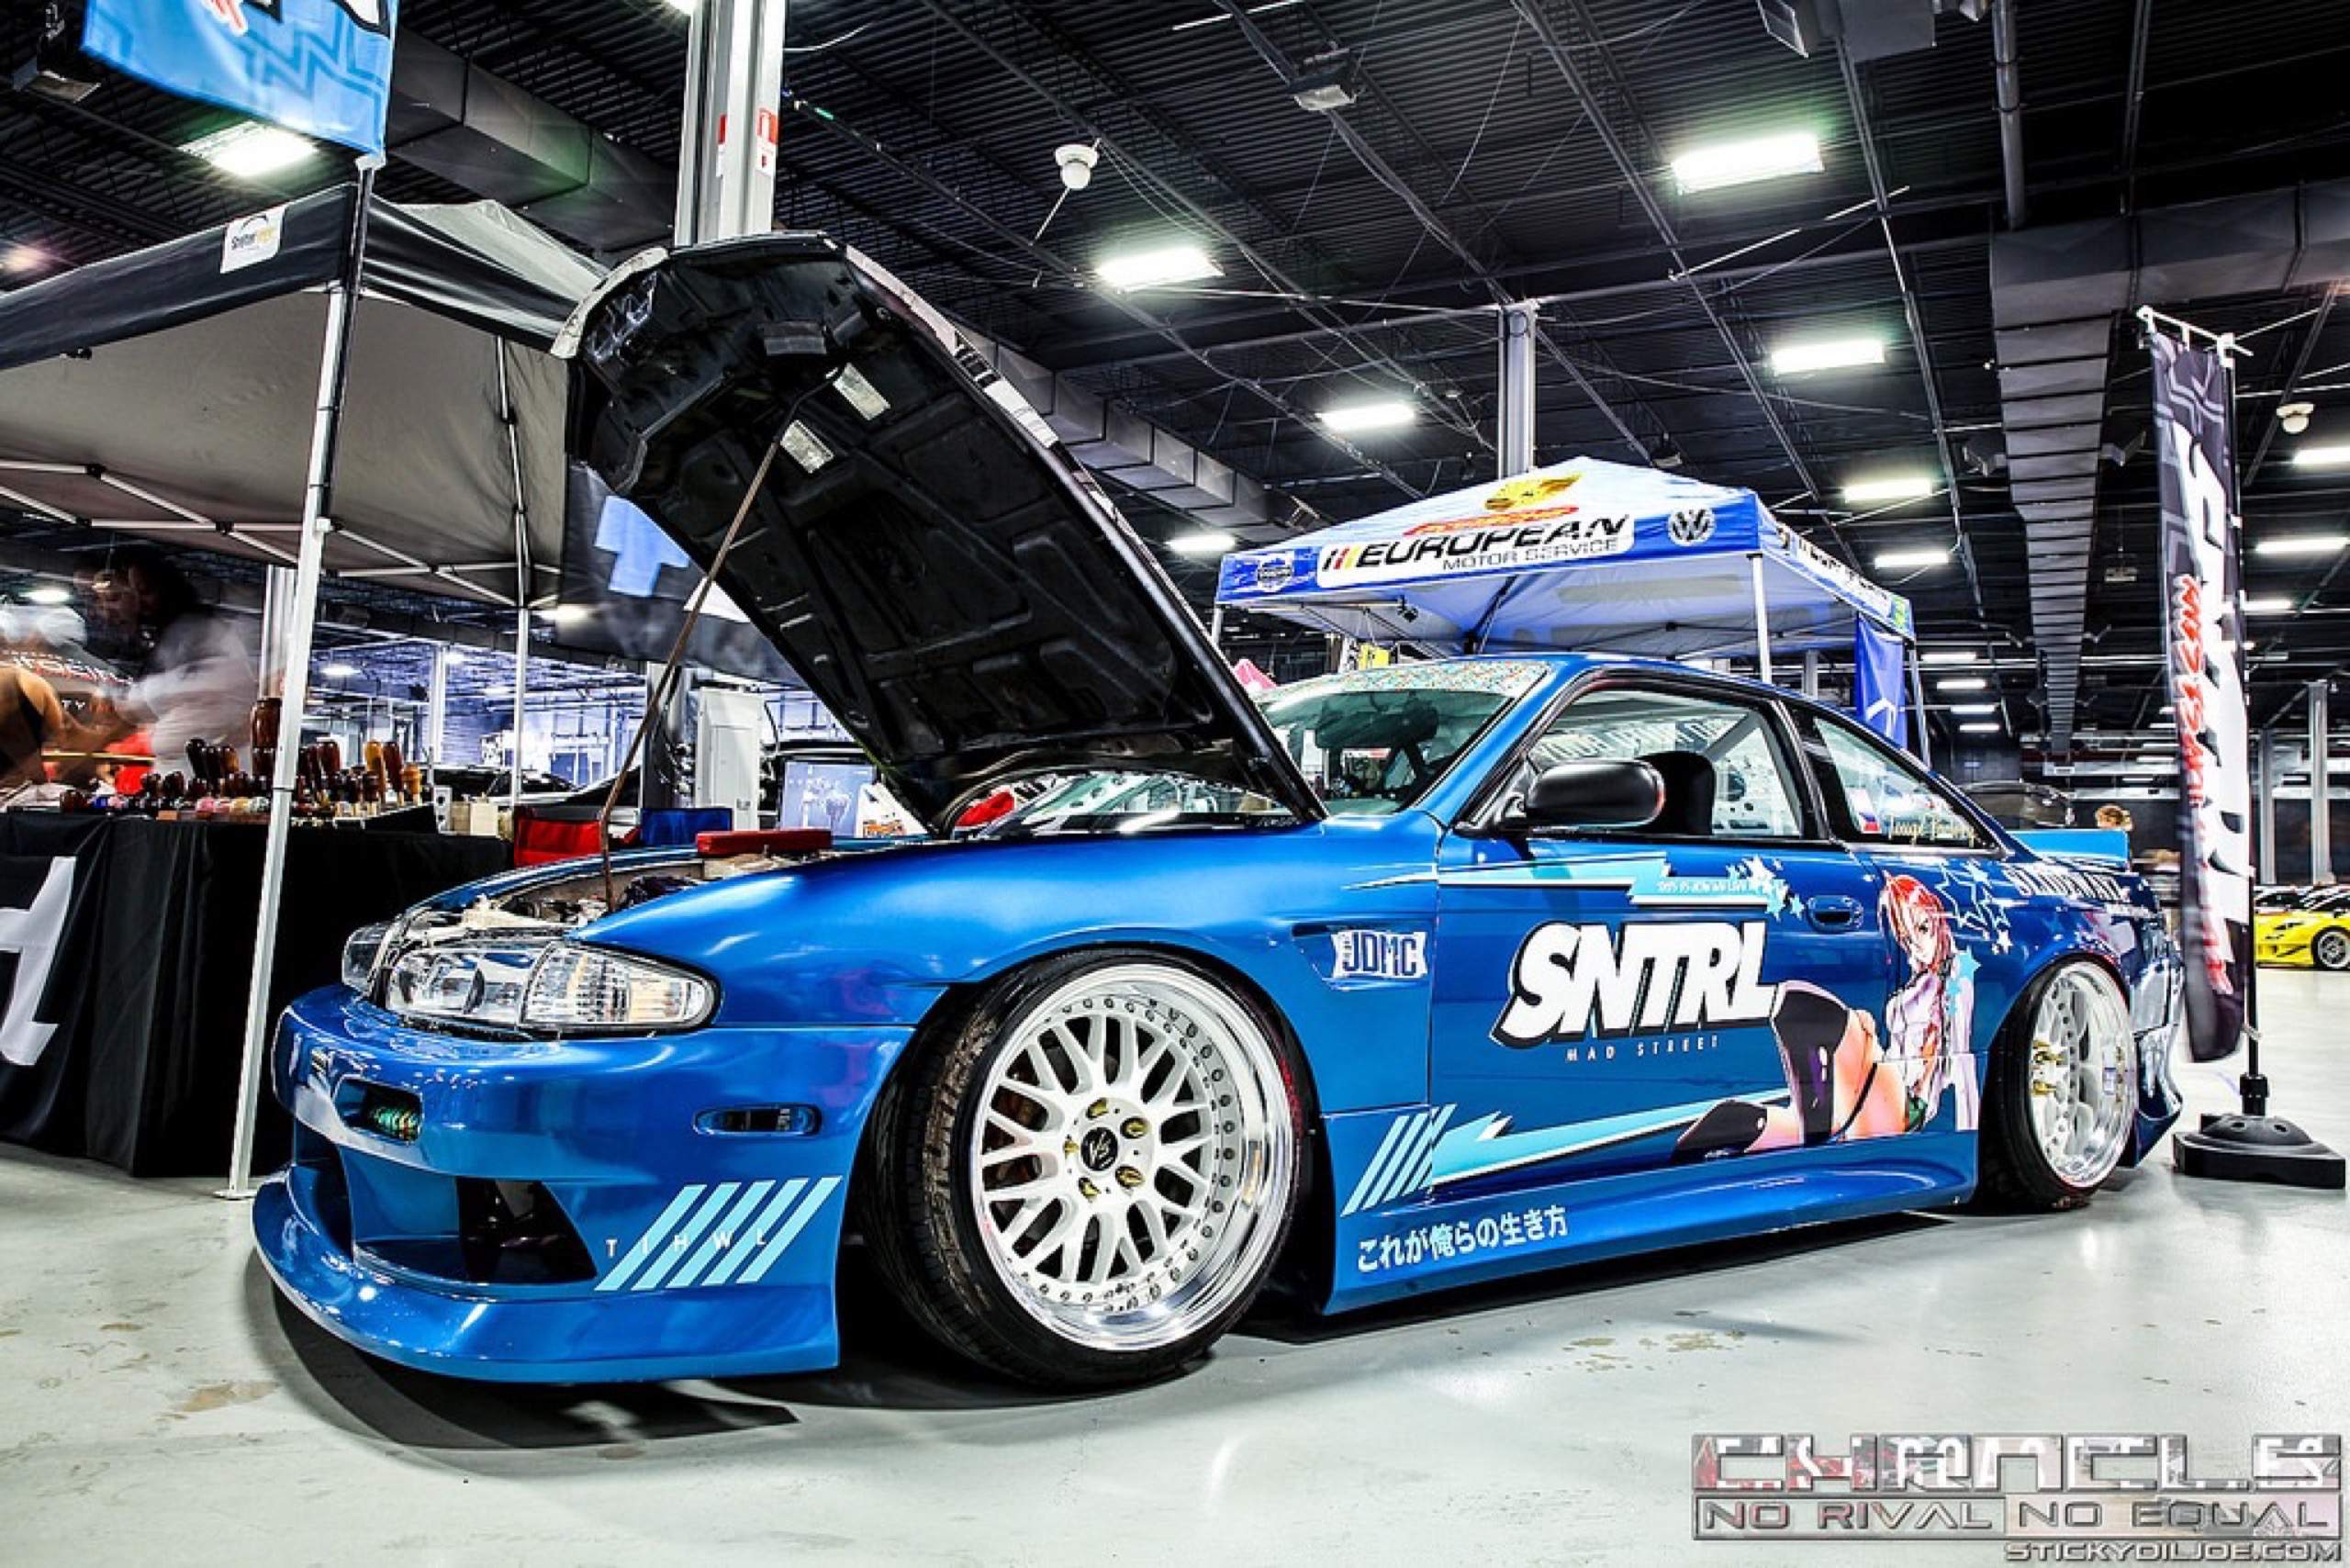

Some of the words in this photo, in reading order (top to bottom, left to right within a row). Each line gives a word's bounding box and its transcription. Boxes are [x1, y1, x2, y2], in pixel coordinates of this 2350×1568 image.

[1356, 513, 1631, 568] EUROPEAN
[1442, 550, 1519, 571] MOTOR
[1524, 537, 1619, 563] SERVICE
[1493, 920, 1778, 1045] SNTRL
[1565, 1046, 1616, 1062] MAD
[1357, 1204, 1569, 1272] これが俺らの生き方
